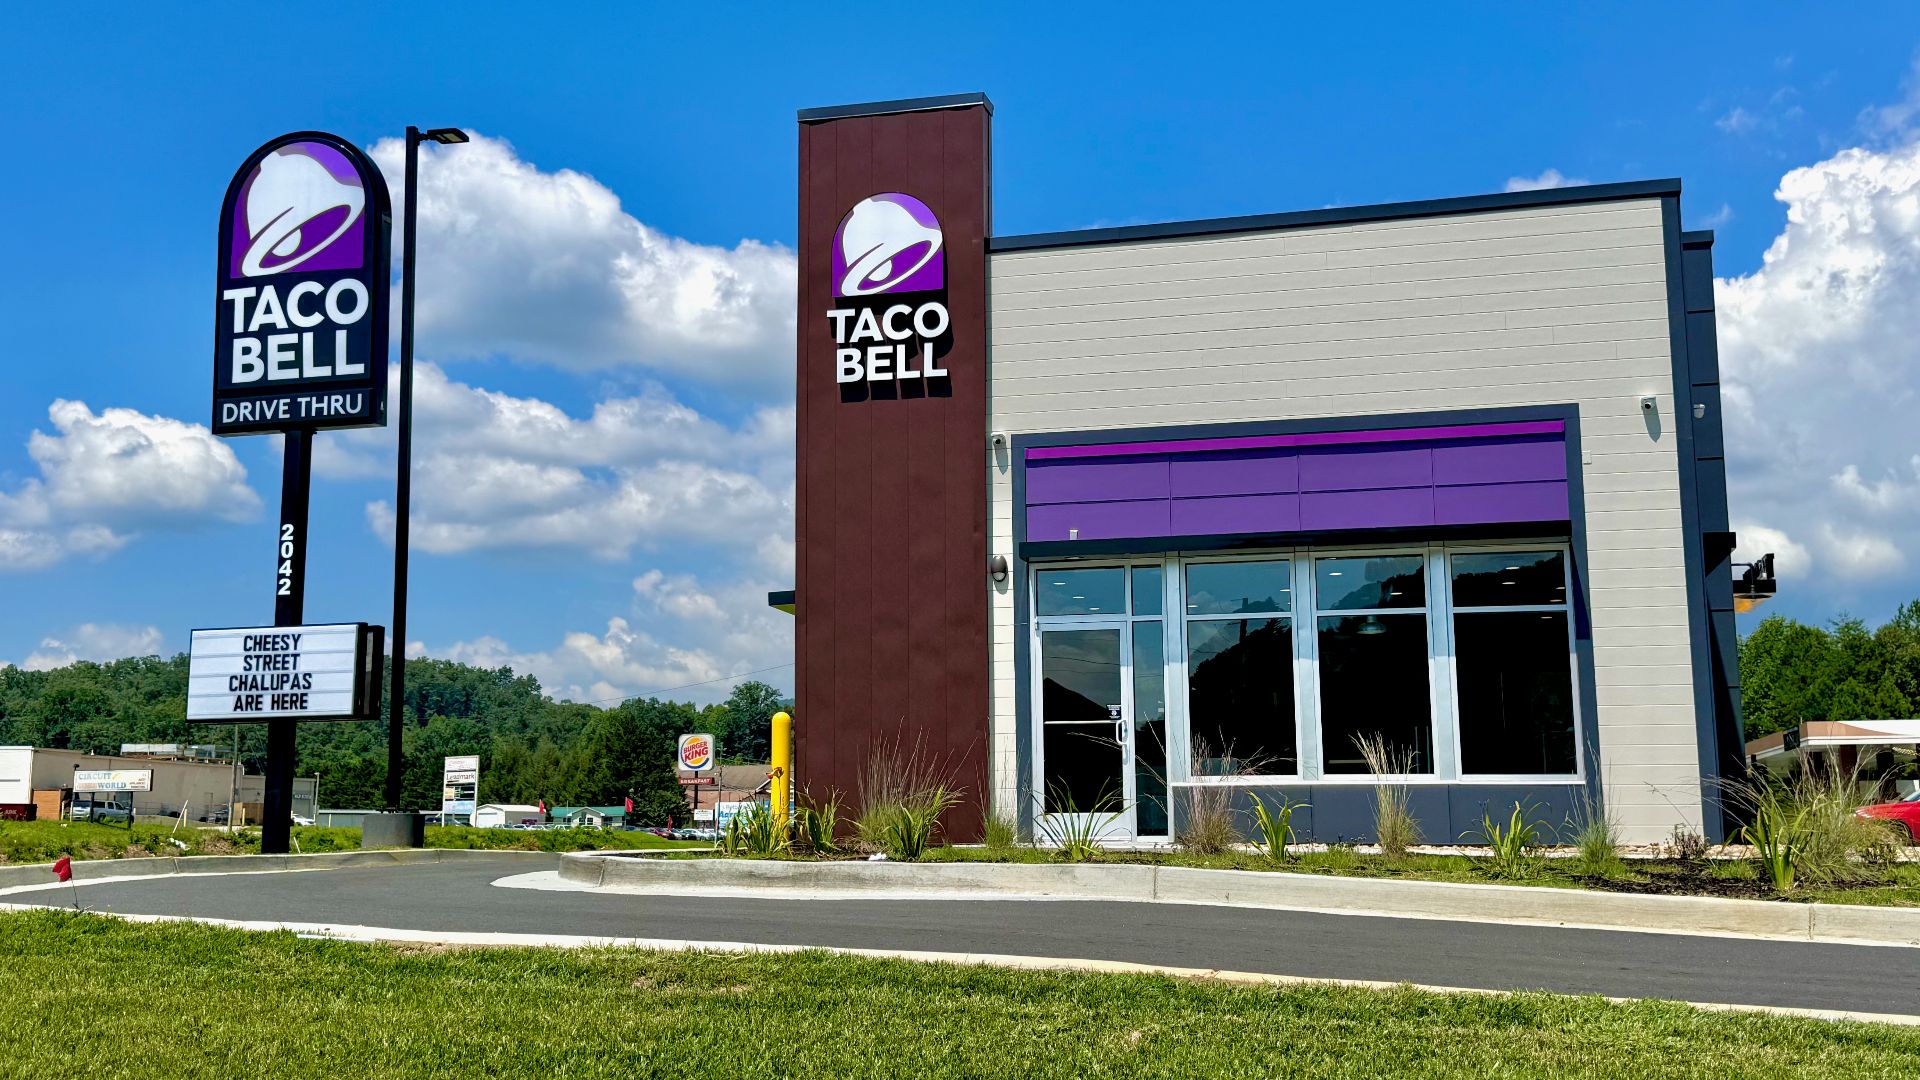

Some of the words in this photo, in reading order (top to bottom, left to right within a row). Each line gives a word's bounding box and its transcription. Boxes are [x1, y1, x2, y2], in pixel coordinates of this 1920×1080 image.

[223, 278, 369, 333] TACO
[826, 301, 950, 344] TACO
[231, 329, 365, 384] BELL
[836, 342, 948, 384] BELL
[222, 398, 291, 424] DRIVE
[297, 393, 363, 417] THRU
[277, 523, 295, 596] 2042
[243, 633, 302, 652] CHEESY
[243, 653, 301, 672] STREET
[228, 672, 313, 692] CHALUPAS
[233, 694, 264, 712] ARE
[270, 692, 309, 711] HERE
[683, 741, 708, 754] BURGER
[684, 747, 709, 763] KING
[78, 772, 112, 780] CIRCUIT
